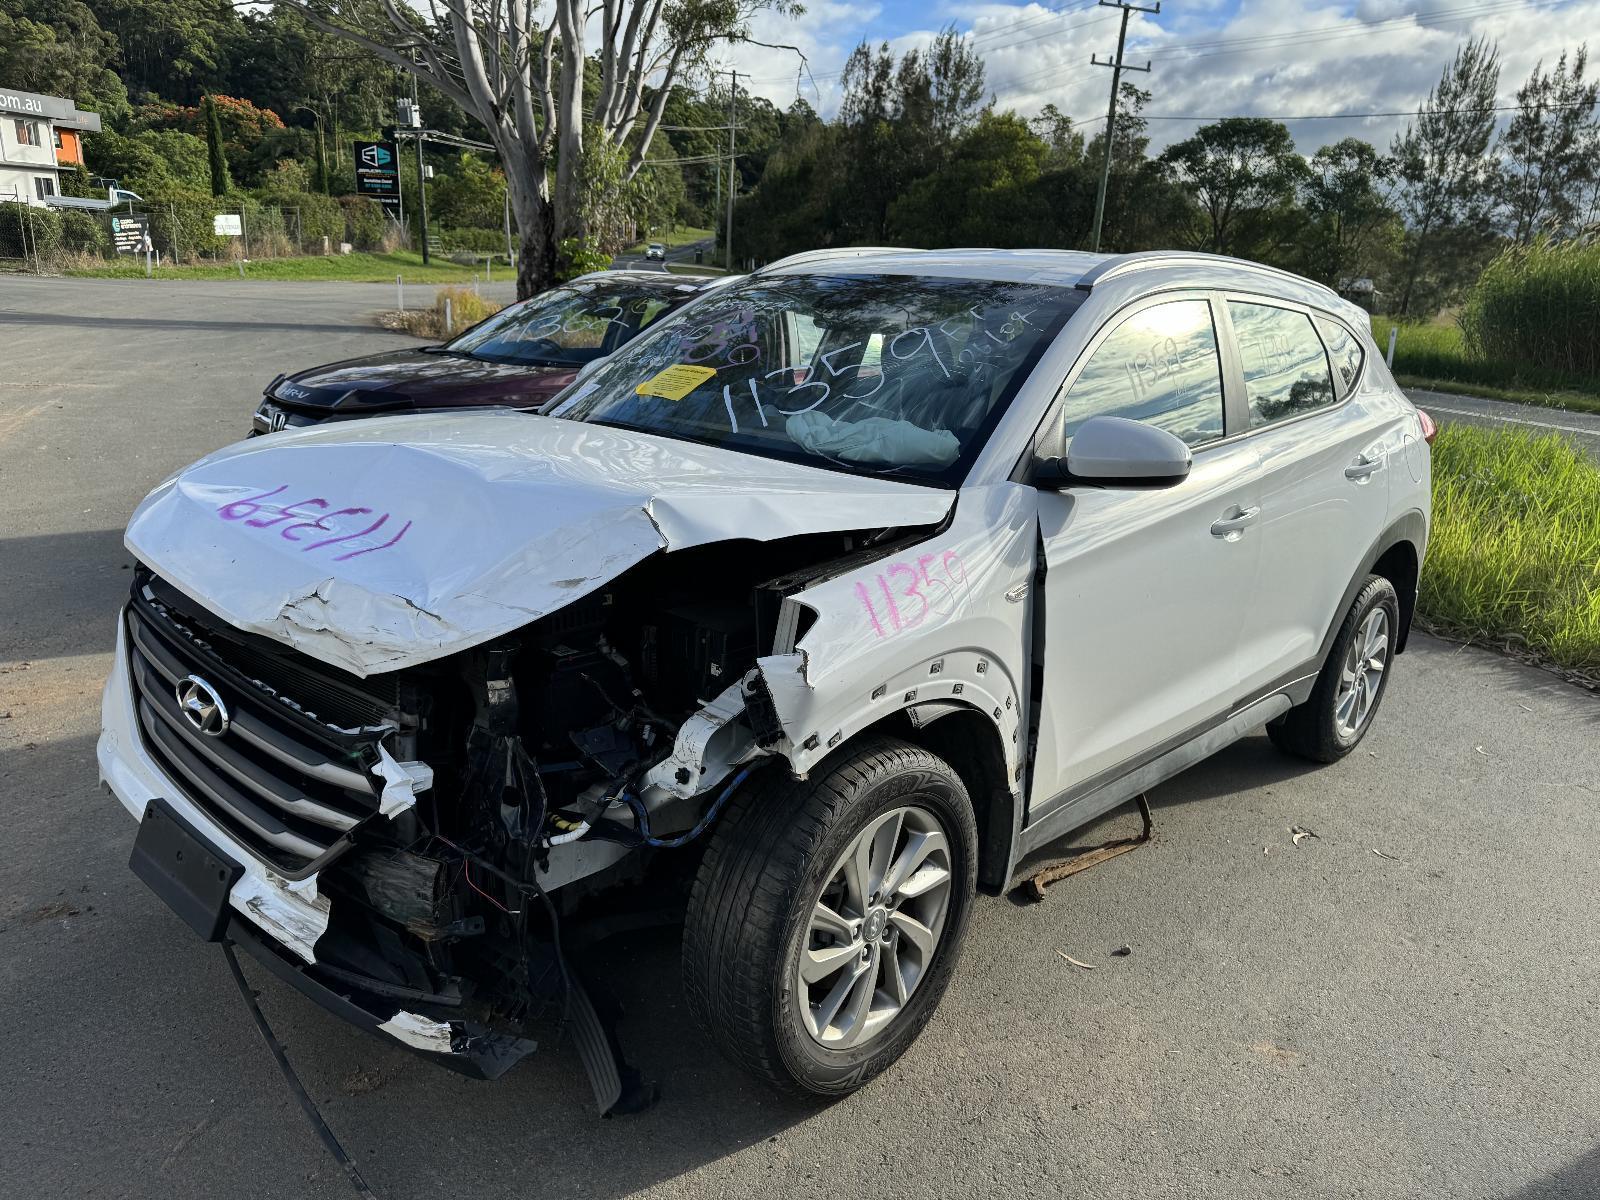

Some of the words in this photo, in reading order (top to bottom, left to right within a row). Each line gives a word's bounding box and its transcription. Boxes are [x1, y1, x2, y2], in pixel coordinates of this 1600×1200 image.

[723, 327, 951, 433] 11359
[1125, 336, 1182, 400] 11359
[216, 484, 412, 561] 11359
[855, 550, 974, 637] 11359
